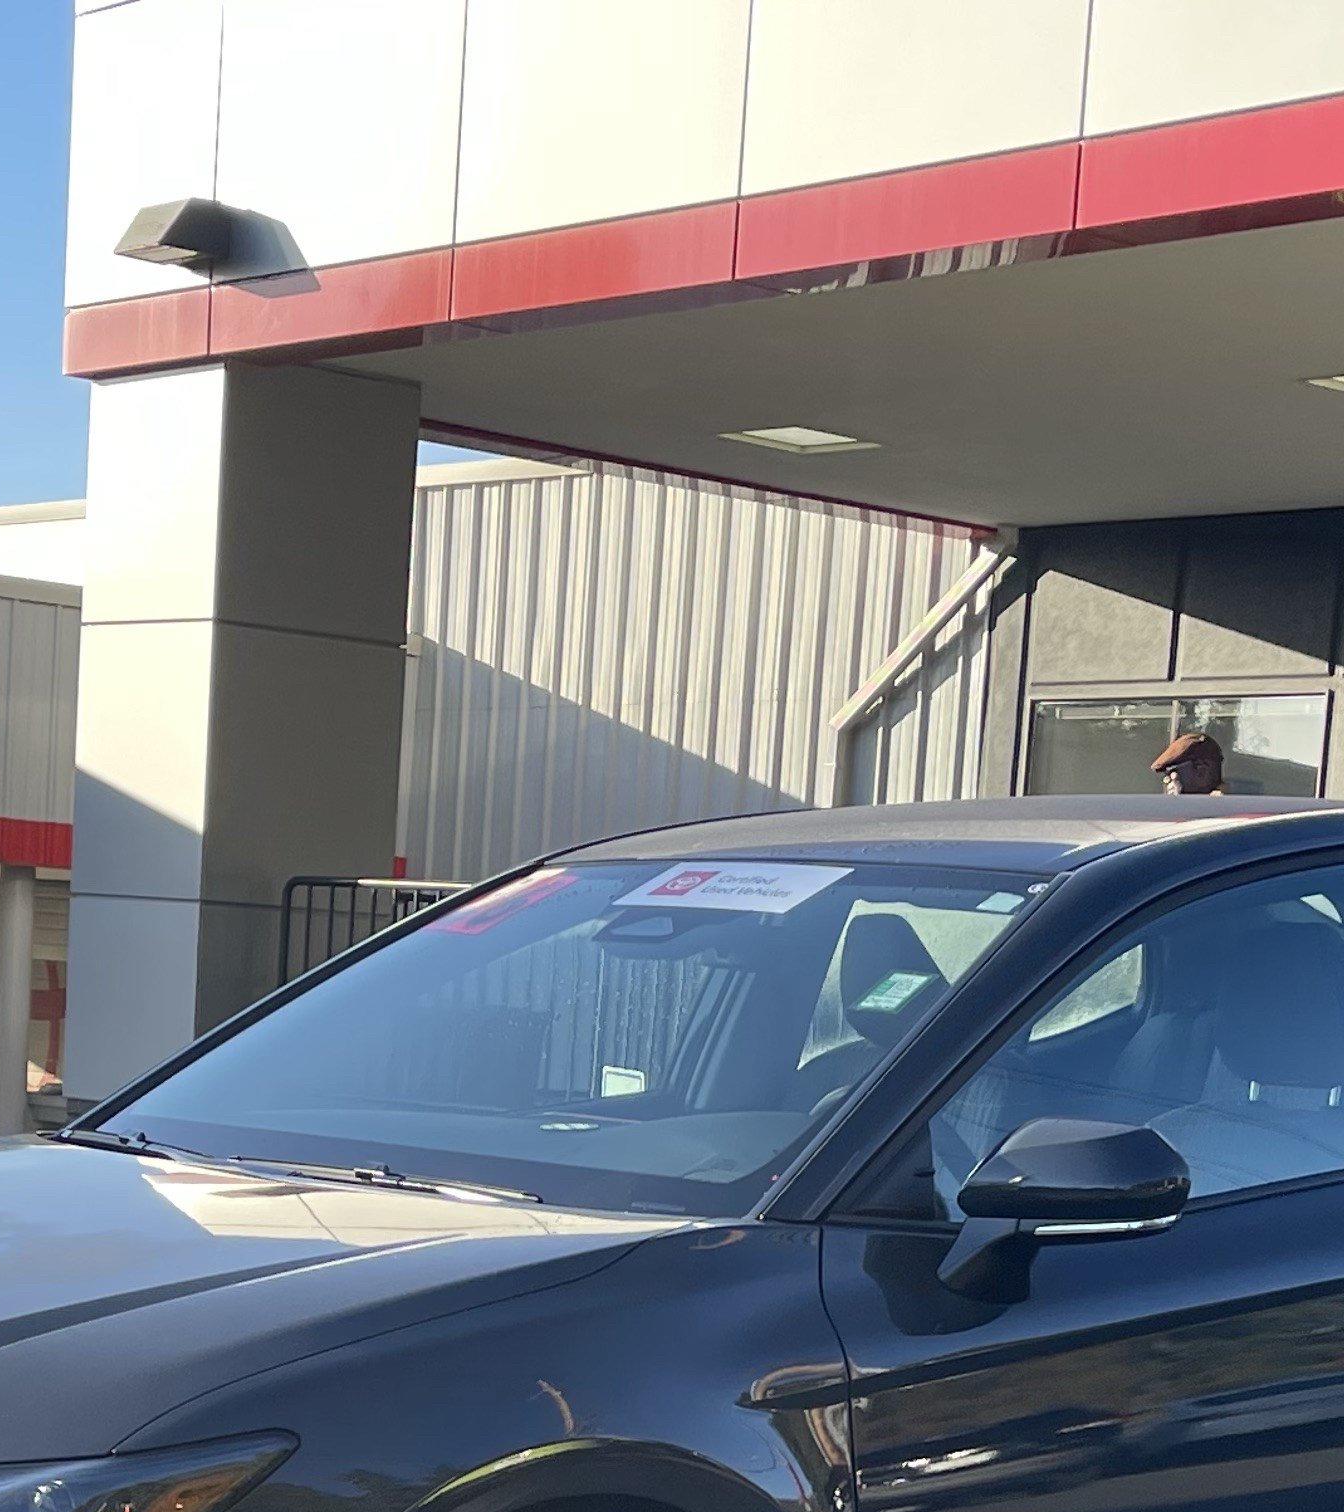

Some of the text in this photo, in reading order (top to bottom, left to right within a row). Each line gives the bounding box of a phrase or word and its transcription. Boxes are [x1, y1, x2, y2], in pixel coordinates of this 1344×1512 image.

[718, 875, 780, 885] Certified
[701, 885, 793, 898] Used Vehicles
